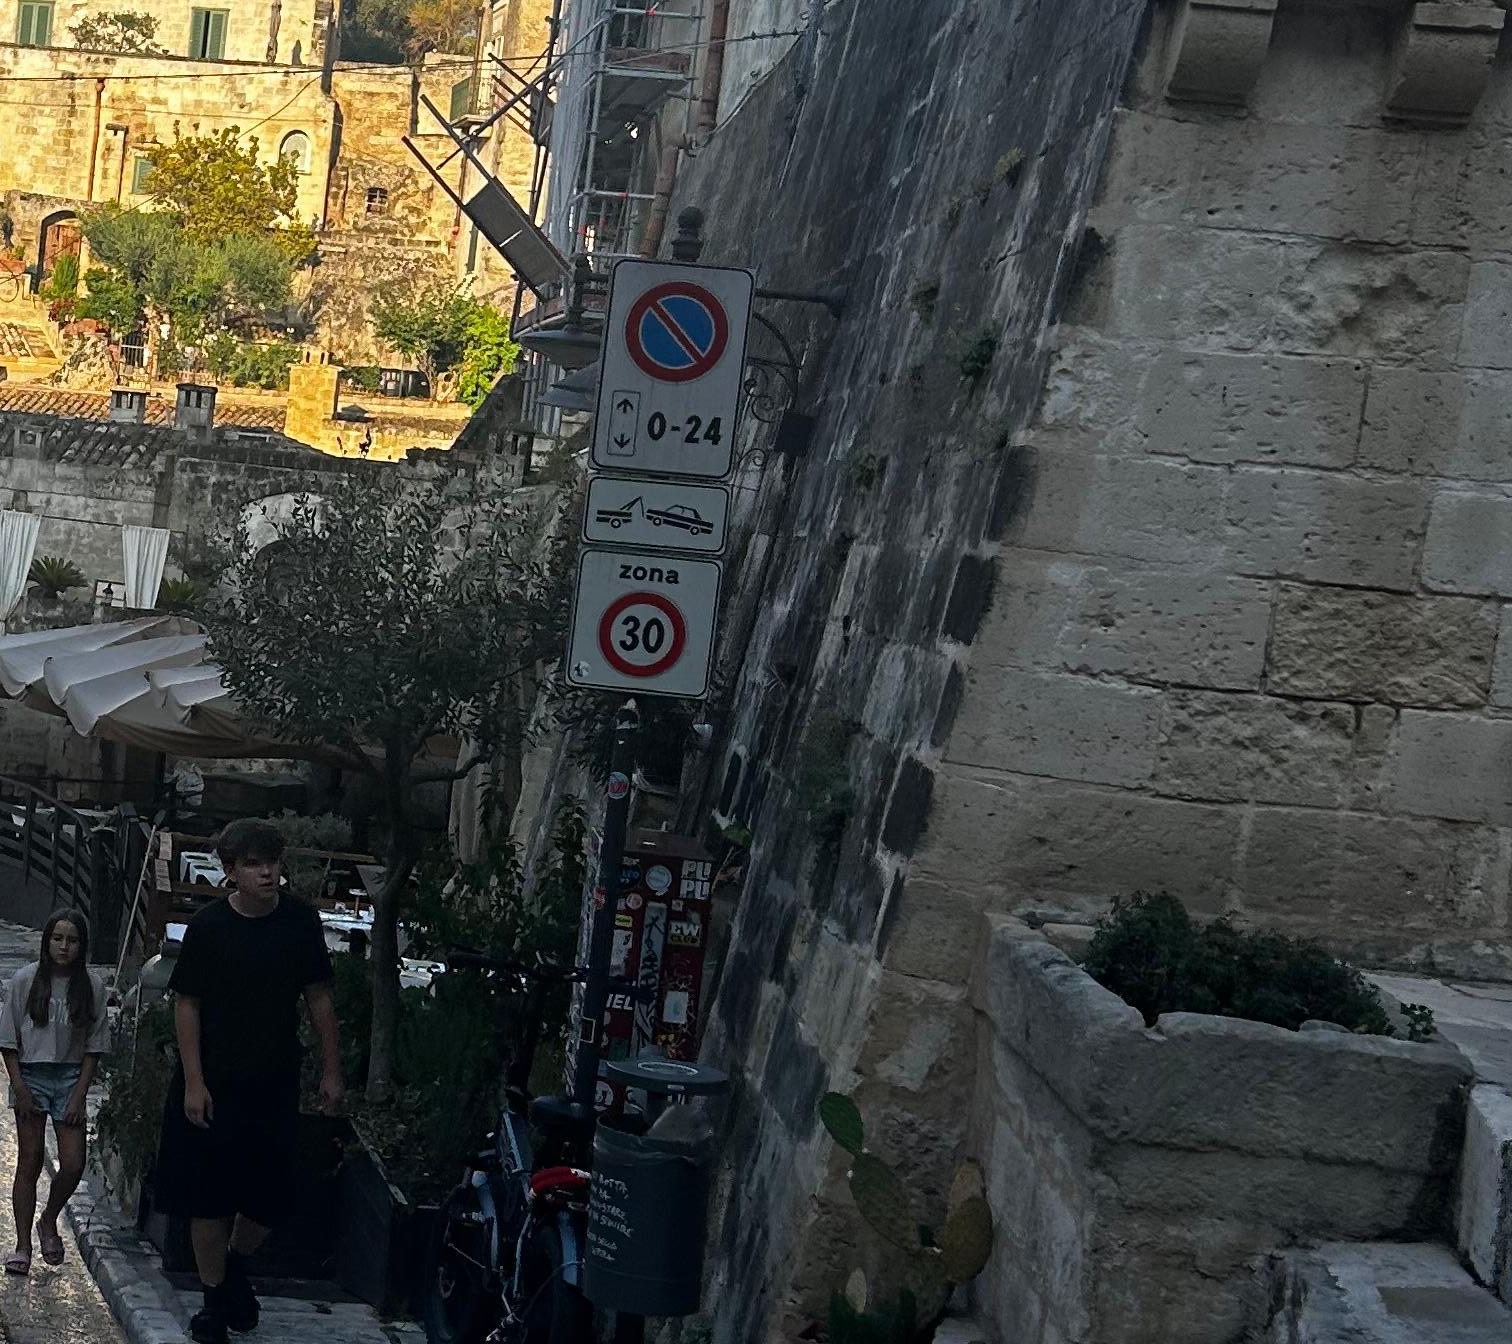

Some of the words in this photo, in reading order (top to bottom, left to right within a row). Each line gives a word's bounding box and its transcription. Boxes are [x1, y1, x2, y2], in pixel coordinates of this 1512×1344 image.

[647, 411, 722, 446] 0-24
[619, 563, 680, 585] zona
[619, 615, 665, 653] 30
